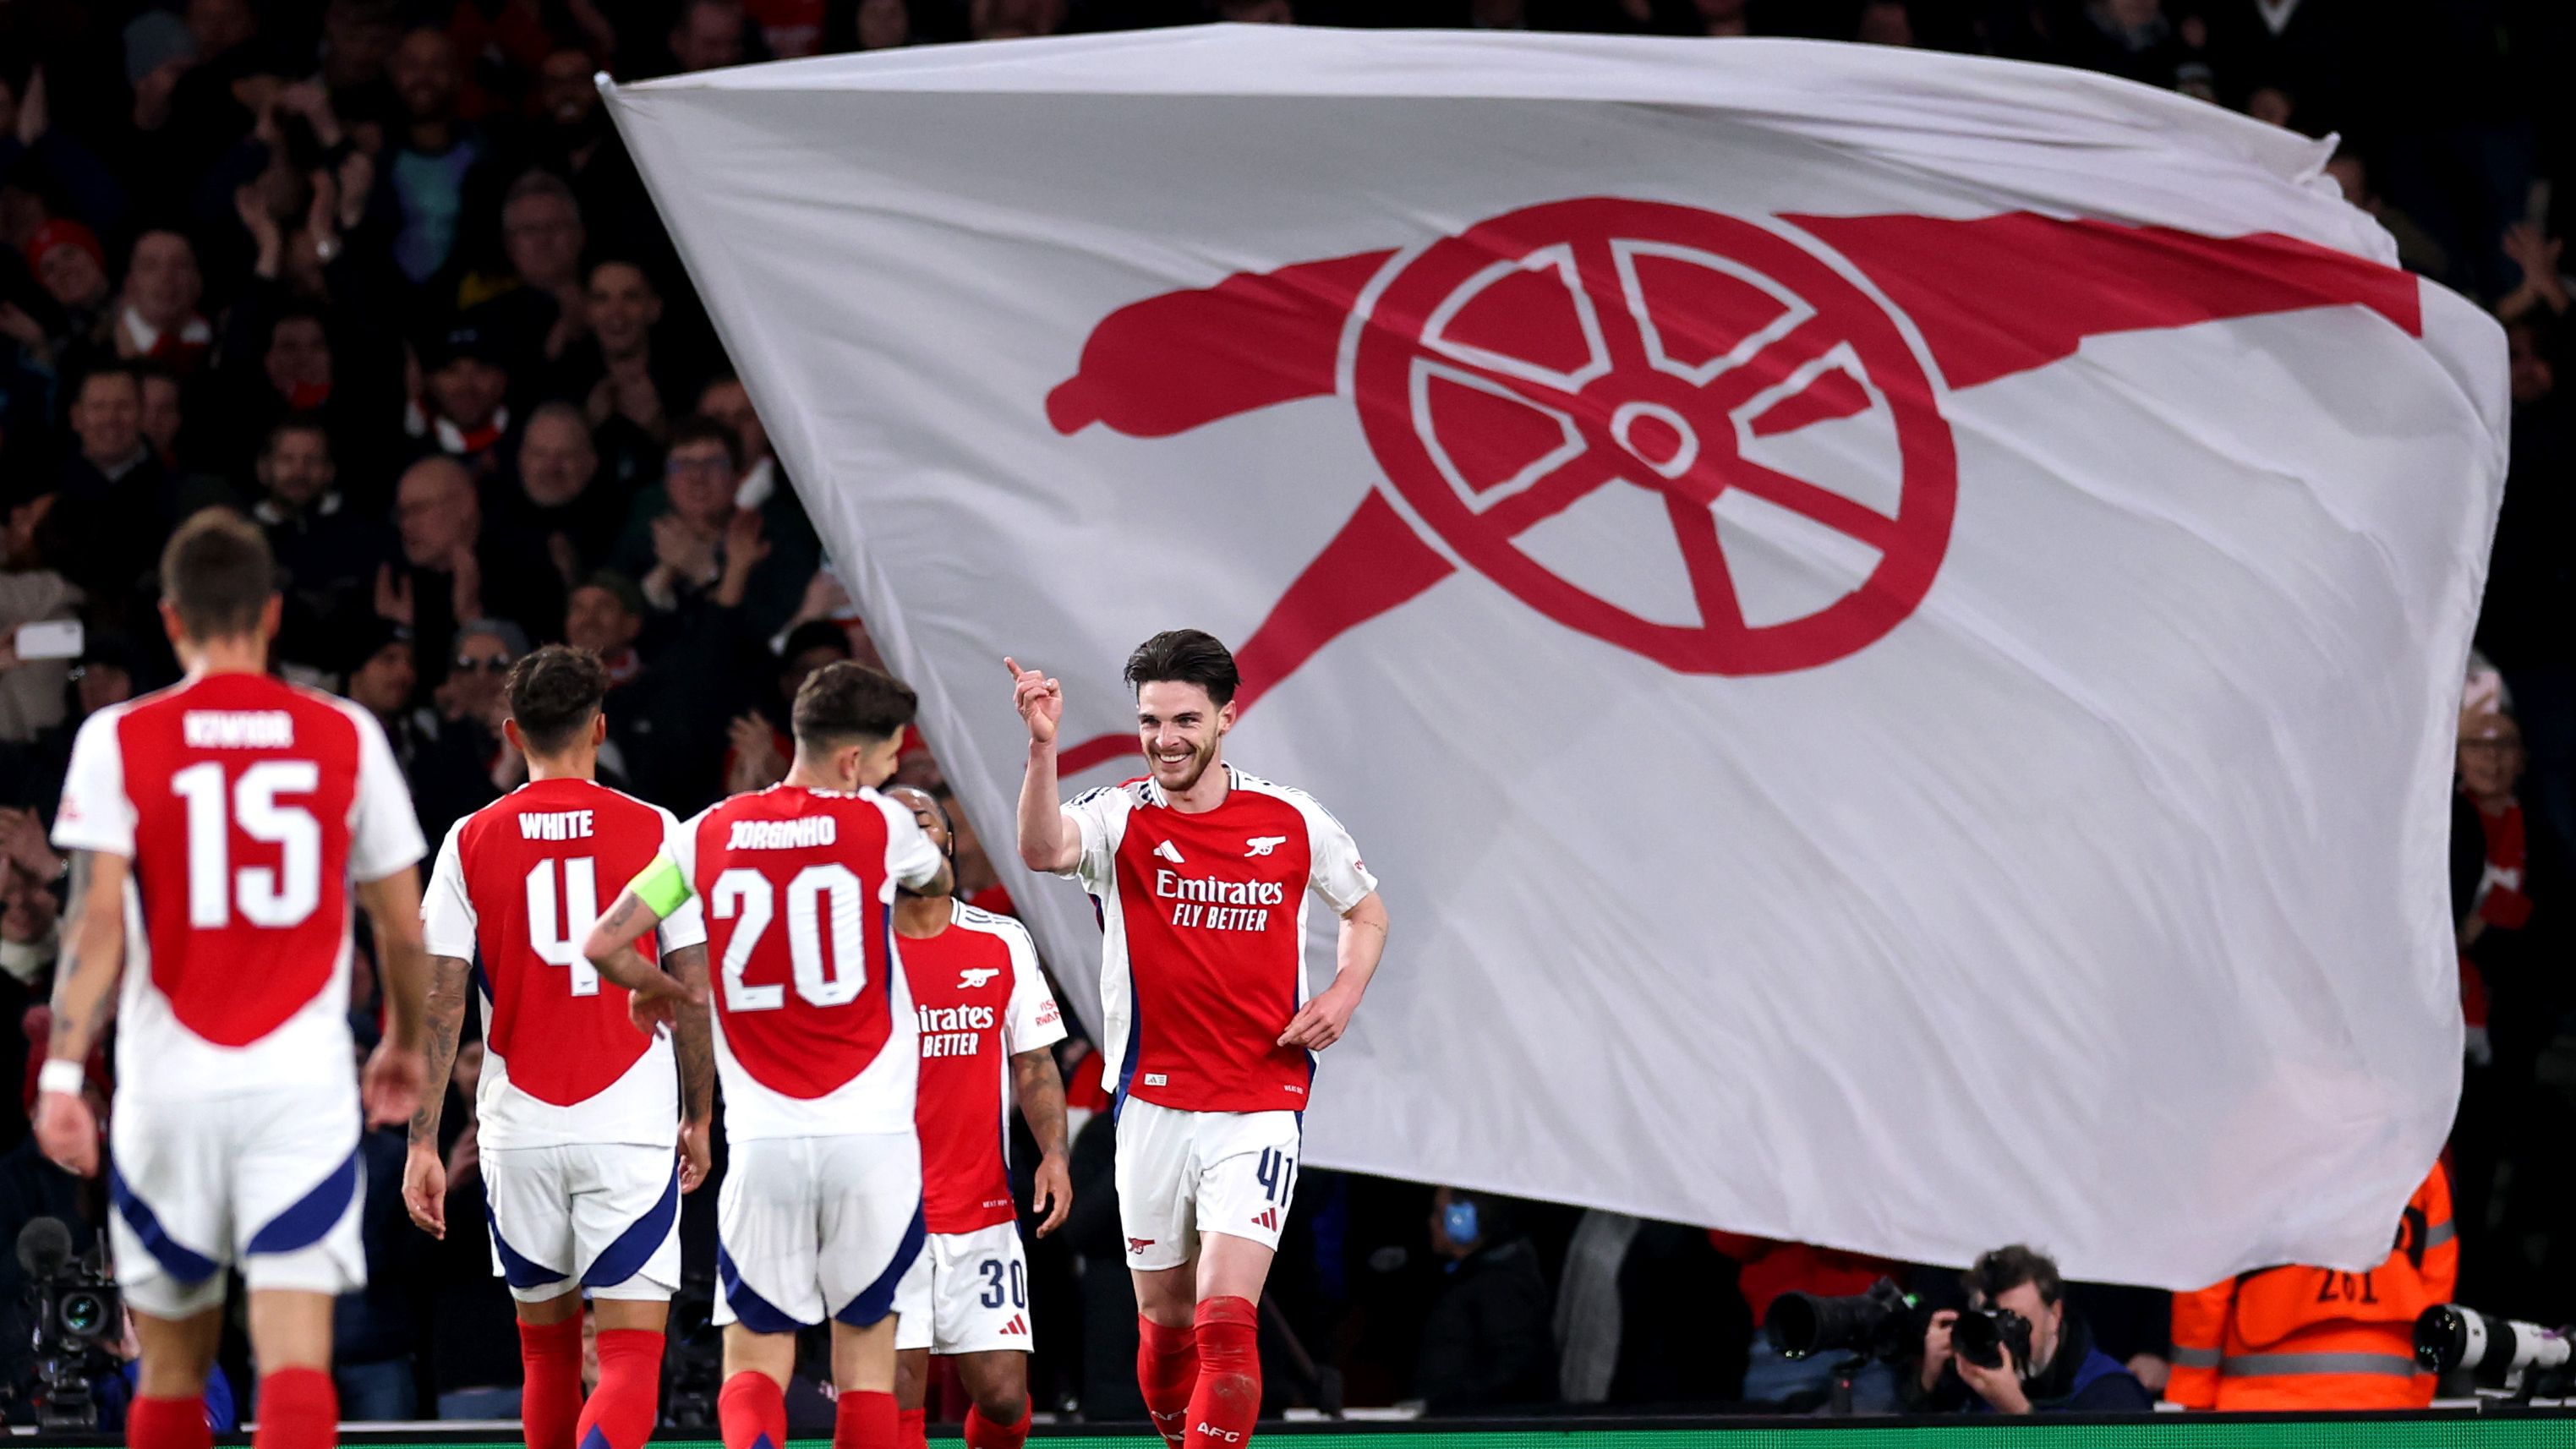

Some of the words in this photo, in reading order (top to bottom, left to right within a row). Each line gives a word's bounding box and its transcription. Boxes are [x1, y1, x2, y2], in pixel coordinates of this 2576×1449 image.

[518, 810, 593, 841] WHITE
[725, 816, 836, 850] JORGINHO
[172, 761, 320, 928] 15
[1156, 868, 1283, 905] Emirates
[526, 856, 600, 998] 4
[1172, 903, 1204, 928] FLY
[1206, 906, 1268, 932] BETTER
[711, 861, 867, 1013] 20
[922, 1031, 979, 1058] BETTER
[1256, 1146, 1293, 1210] 41
[979, 1259, 1025, 1310] 30
[1196, 1421, 1240, 1443] AFC
